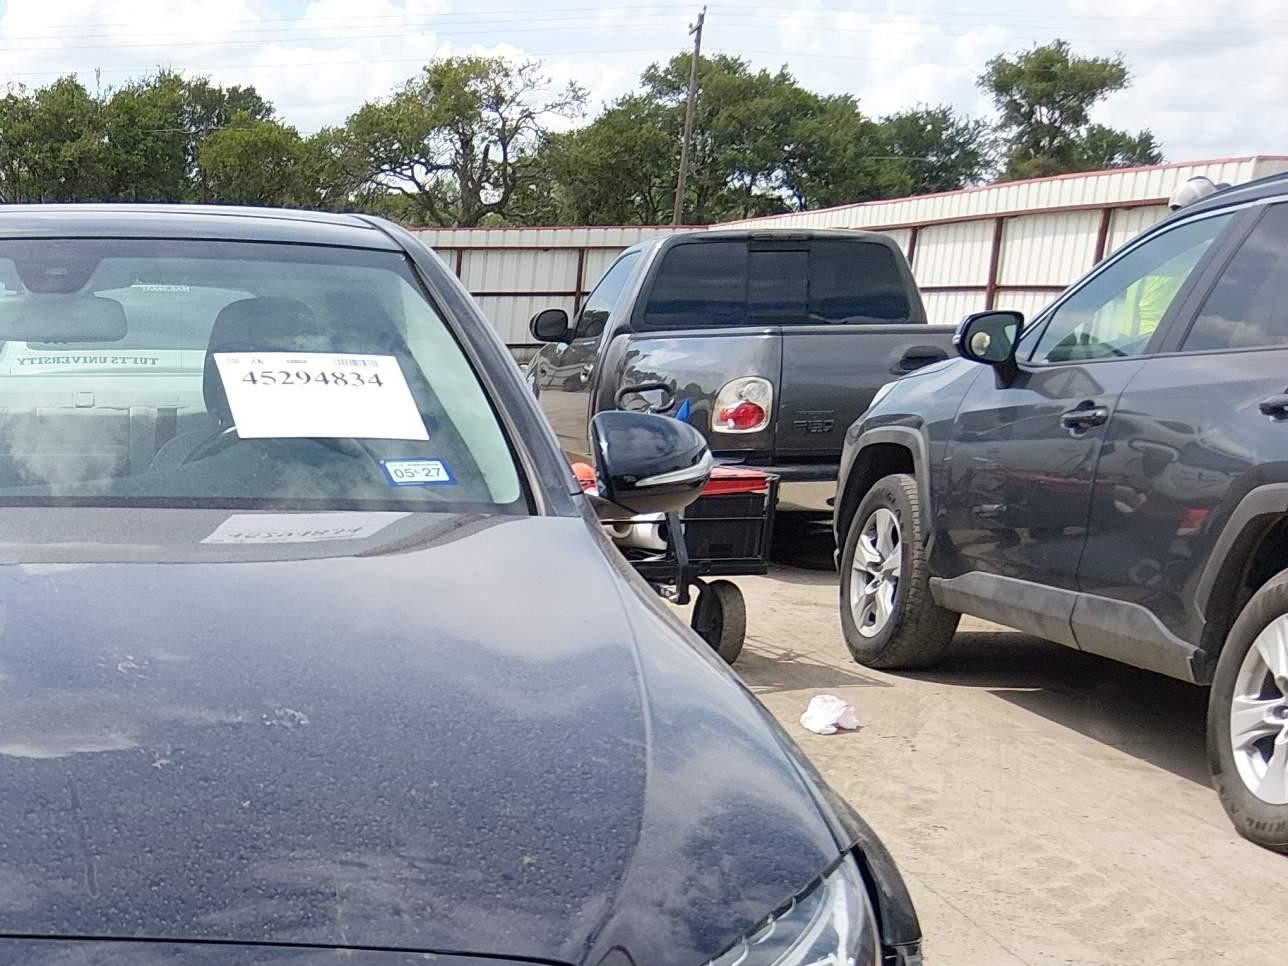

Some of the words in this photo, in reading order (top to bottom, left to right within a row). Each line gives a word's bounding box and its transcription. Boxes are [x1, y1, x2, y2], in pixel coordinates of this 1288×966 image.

[242, 370, 384, 387] 45294834
[393, 468, 415, 479] 05
[422, 467, 441, 478] 27
